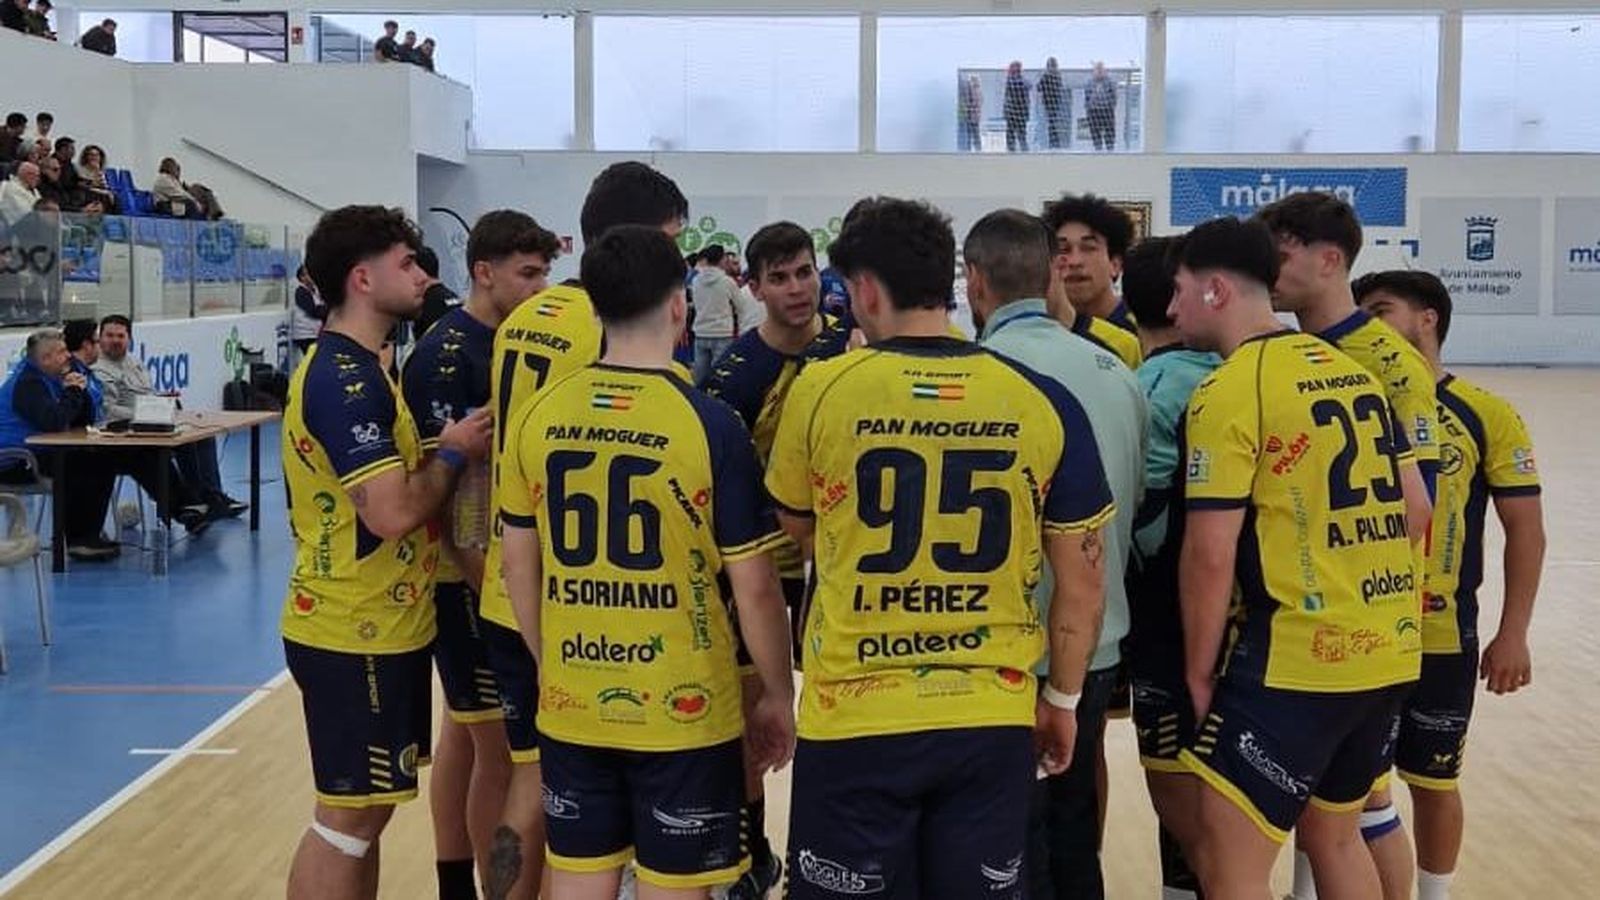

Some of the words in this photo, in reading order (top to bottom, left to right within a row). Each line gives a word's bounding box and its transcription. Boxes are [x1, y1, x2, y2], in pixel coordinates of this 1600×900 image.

[1297, 380, 1325, 395] PAN
[545, 426, 583, 441] PAN
[586, 429, 670, 450] MOGUER
[856, 419, 906, 436] PAN
[909, 420, 1021, 438] MOGUER
[1311, 394, 1405, 511] 23
[545, 451, 665, 572] 66
[855, 447, 1018, 575] 95
[1325, 520, 1354, 549] A.
[563, 578, 679, 611] SORIANO
[853, 585, 874, 614] I.
[880, 578, 991, 614] PÉREZ
[562, 632, 656, 664] platero
[858, 630, 983, 664] platero
